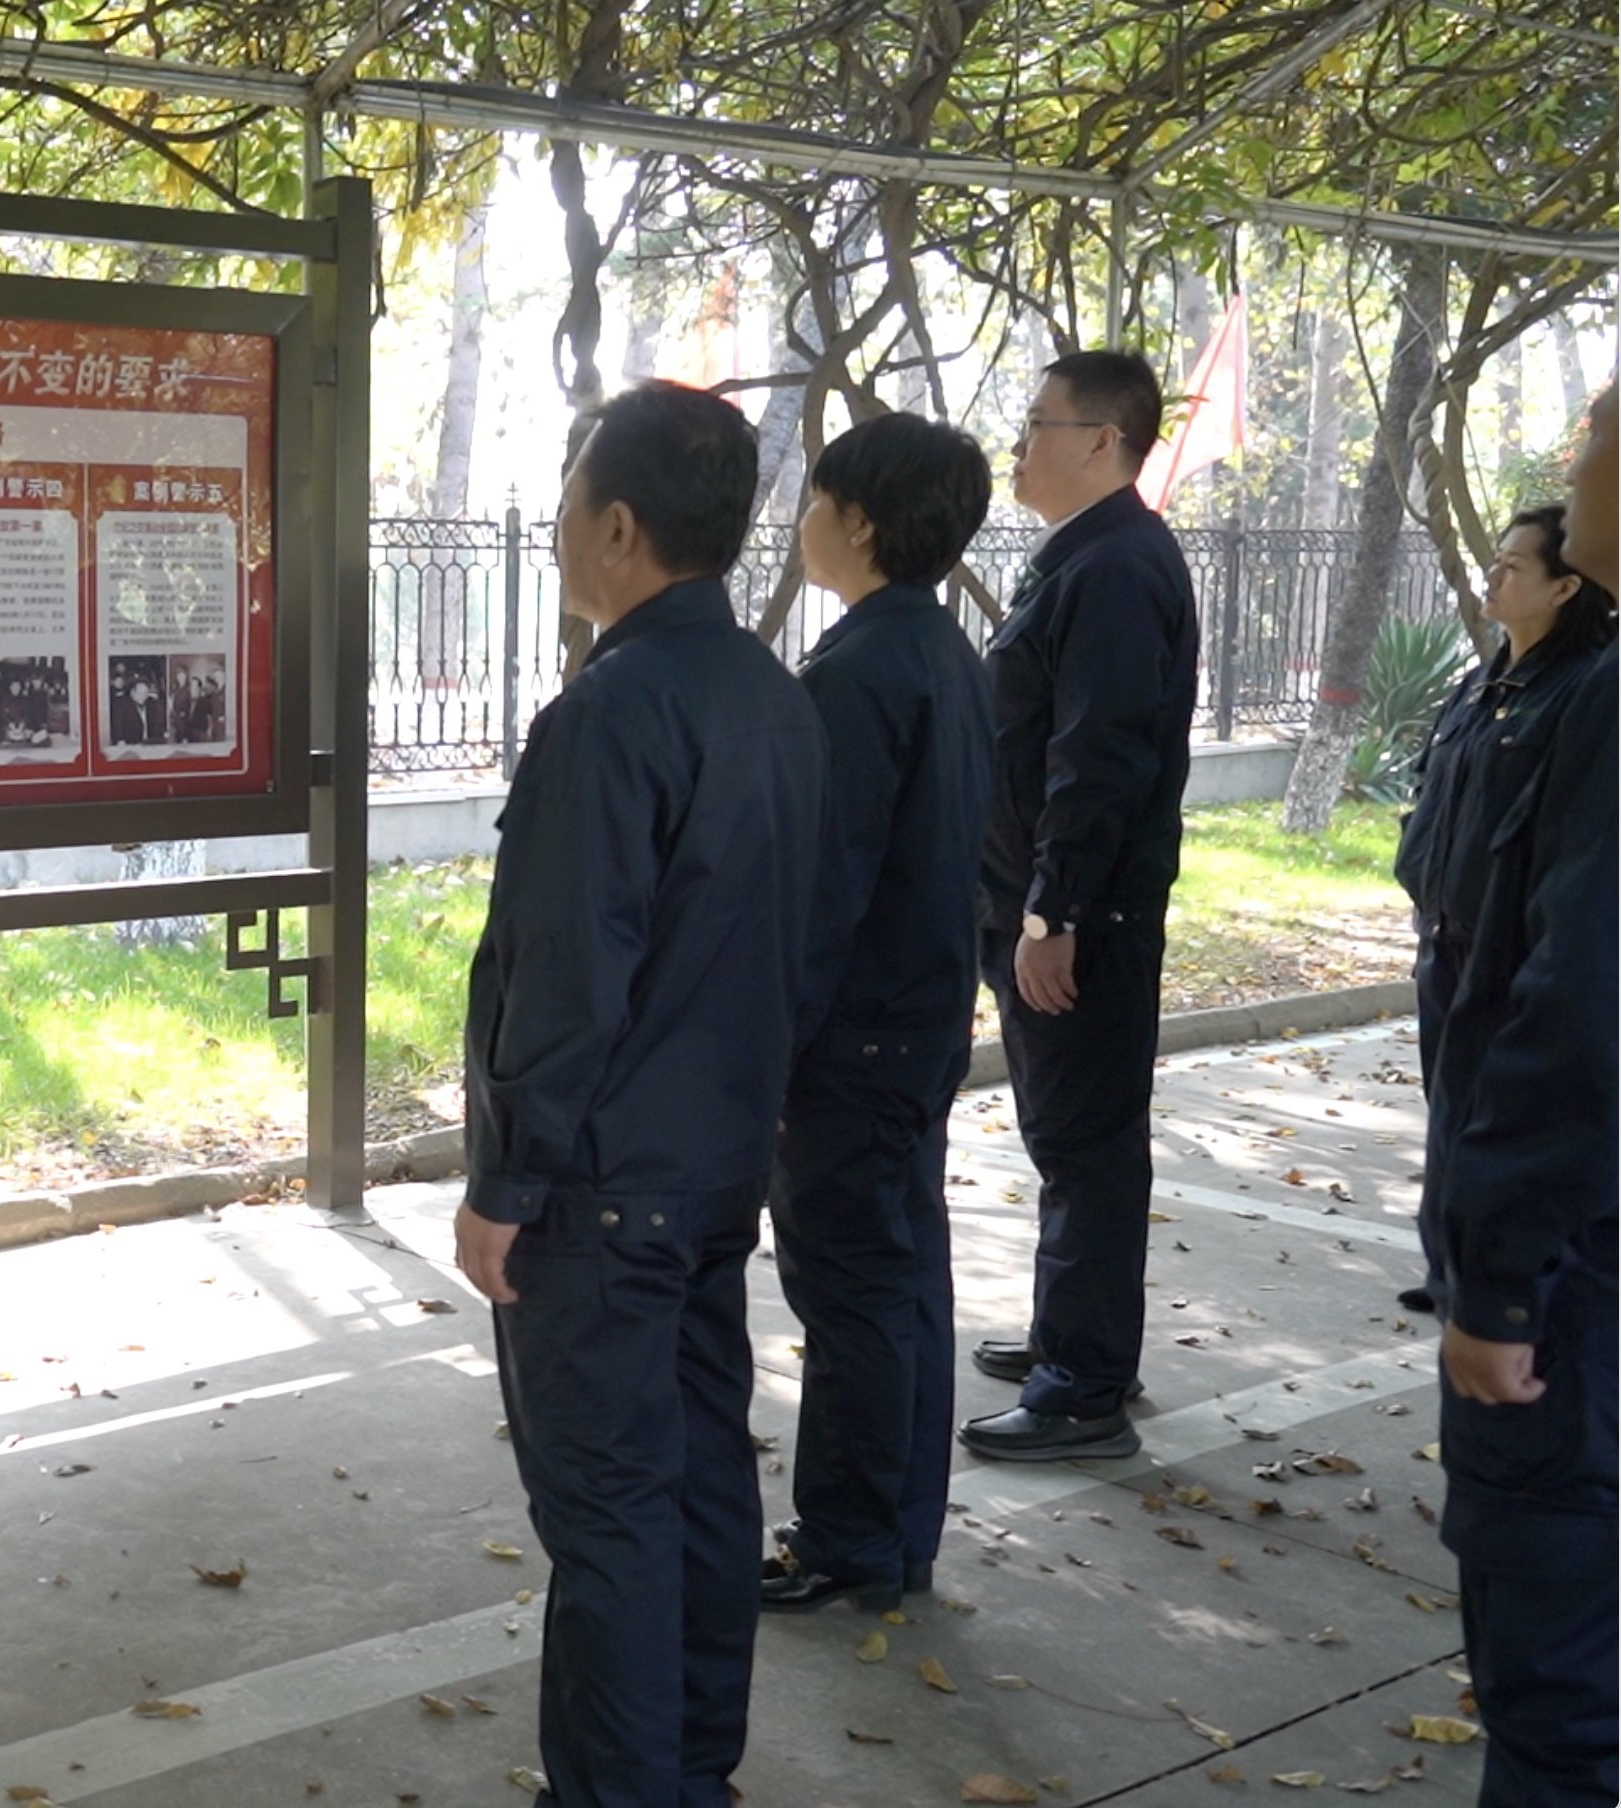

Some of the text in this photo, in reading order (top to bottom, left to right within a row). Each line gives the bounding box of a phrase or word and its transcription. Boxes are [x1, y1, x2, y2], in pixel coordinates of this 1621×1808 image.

[133, 480, 224, 504] 案例警示五
